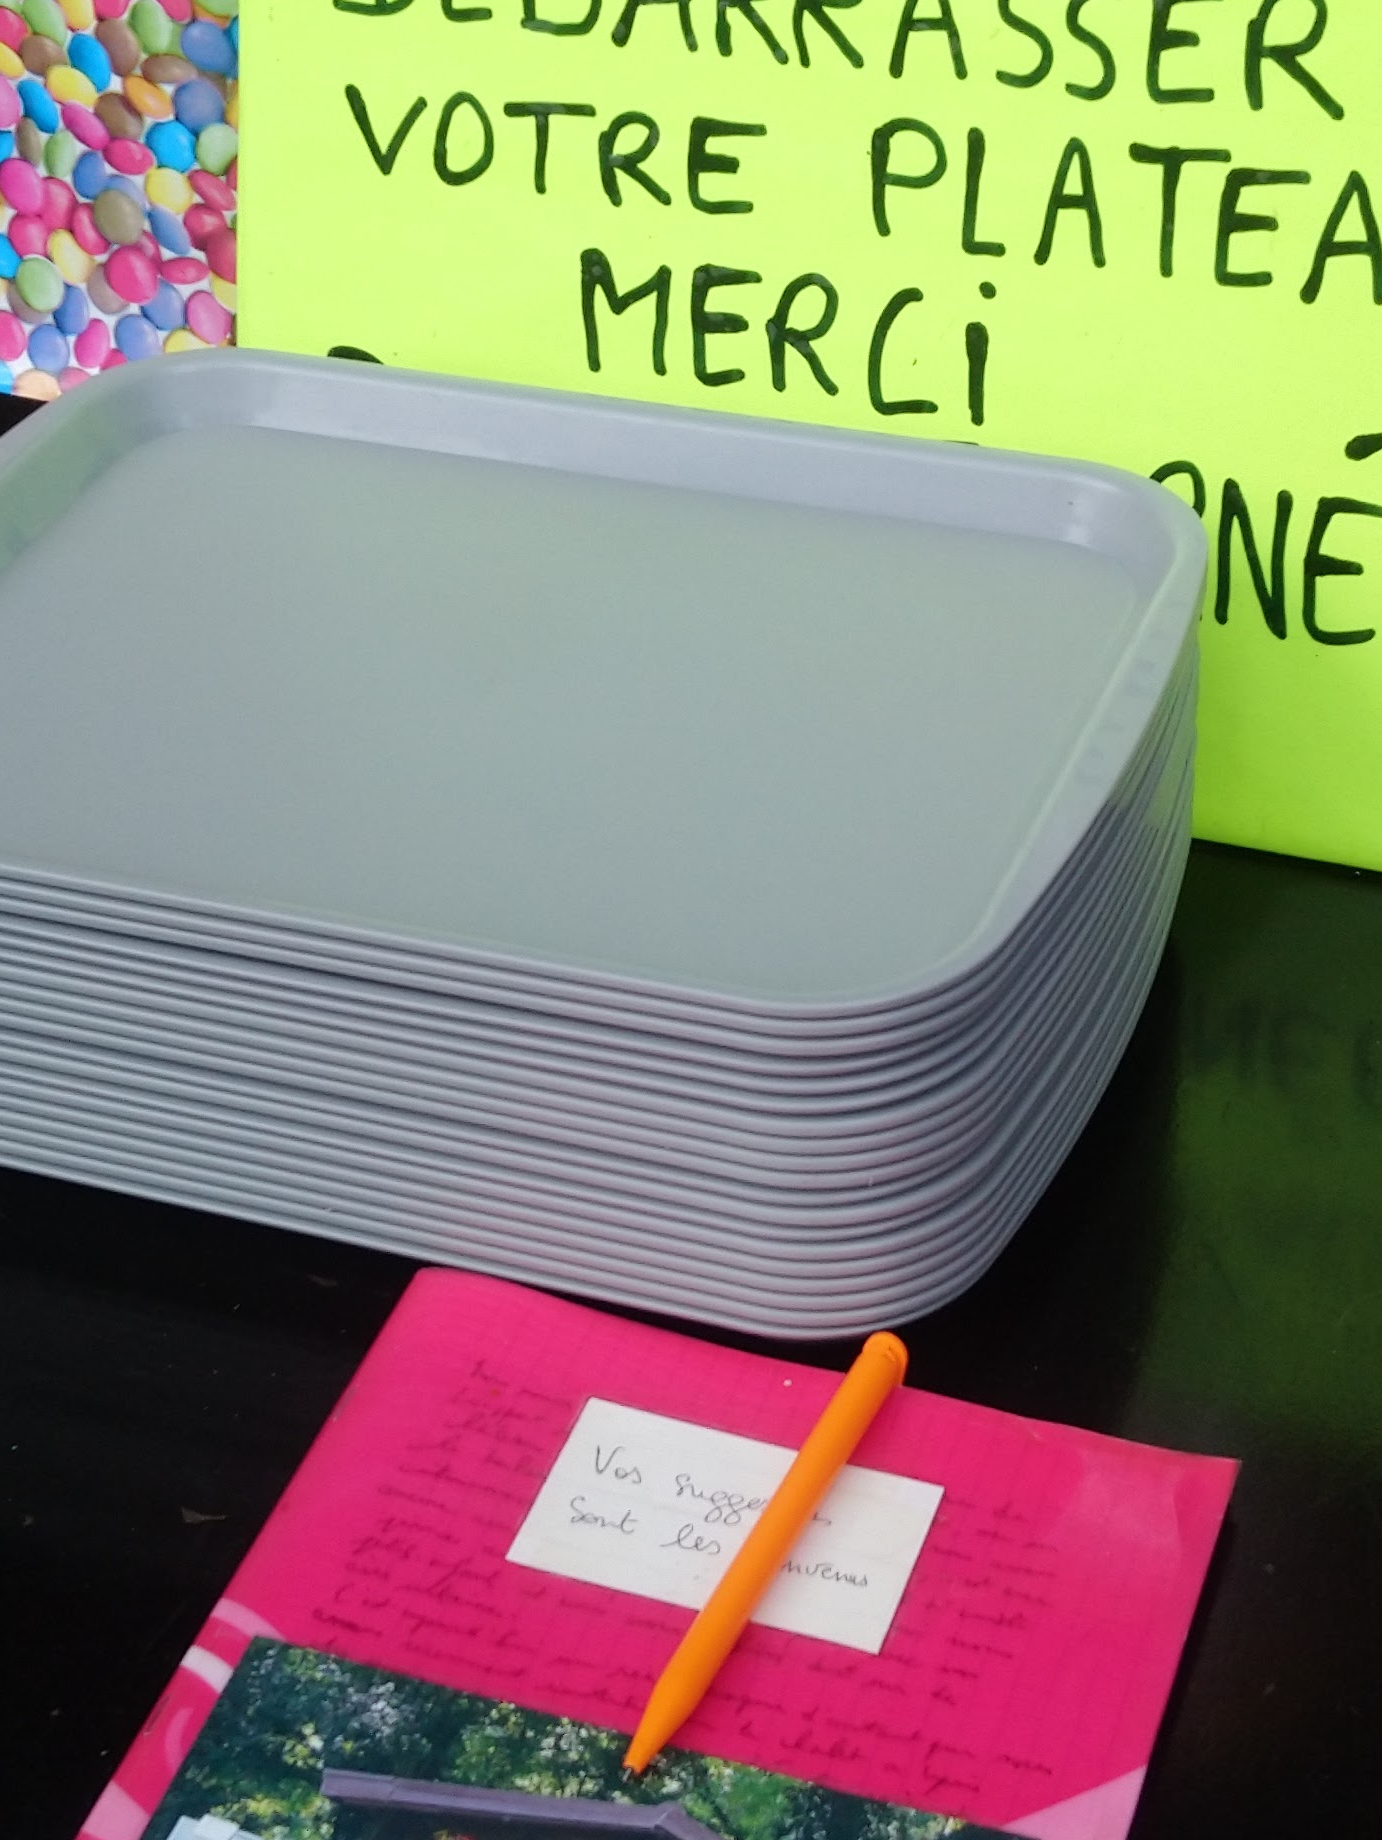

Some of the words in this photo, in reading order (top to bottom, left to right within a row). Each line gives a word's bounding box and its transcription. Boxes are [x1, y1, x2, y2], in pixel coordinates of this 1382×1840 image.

[343, 83, 768, 216] VOTRE
[594, 1444, 643, 1485] Vos
[659, 1523, 722, 1556] les
